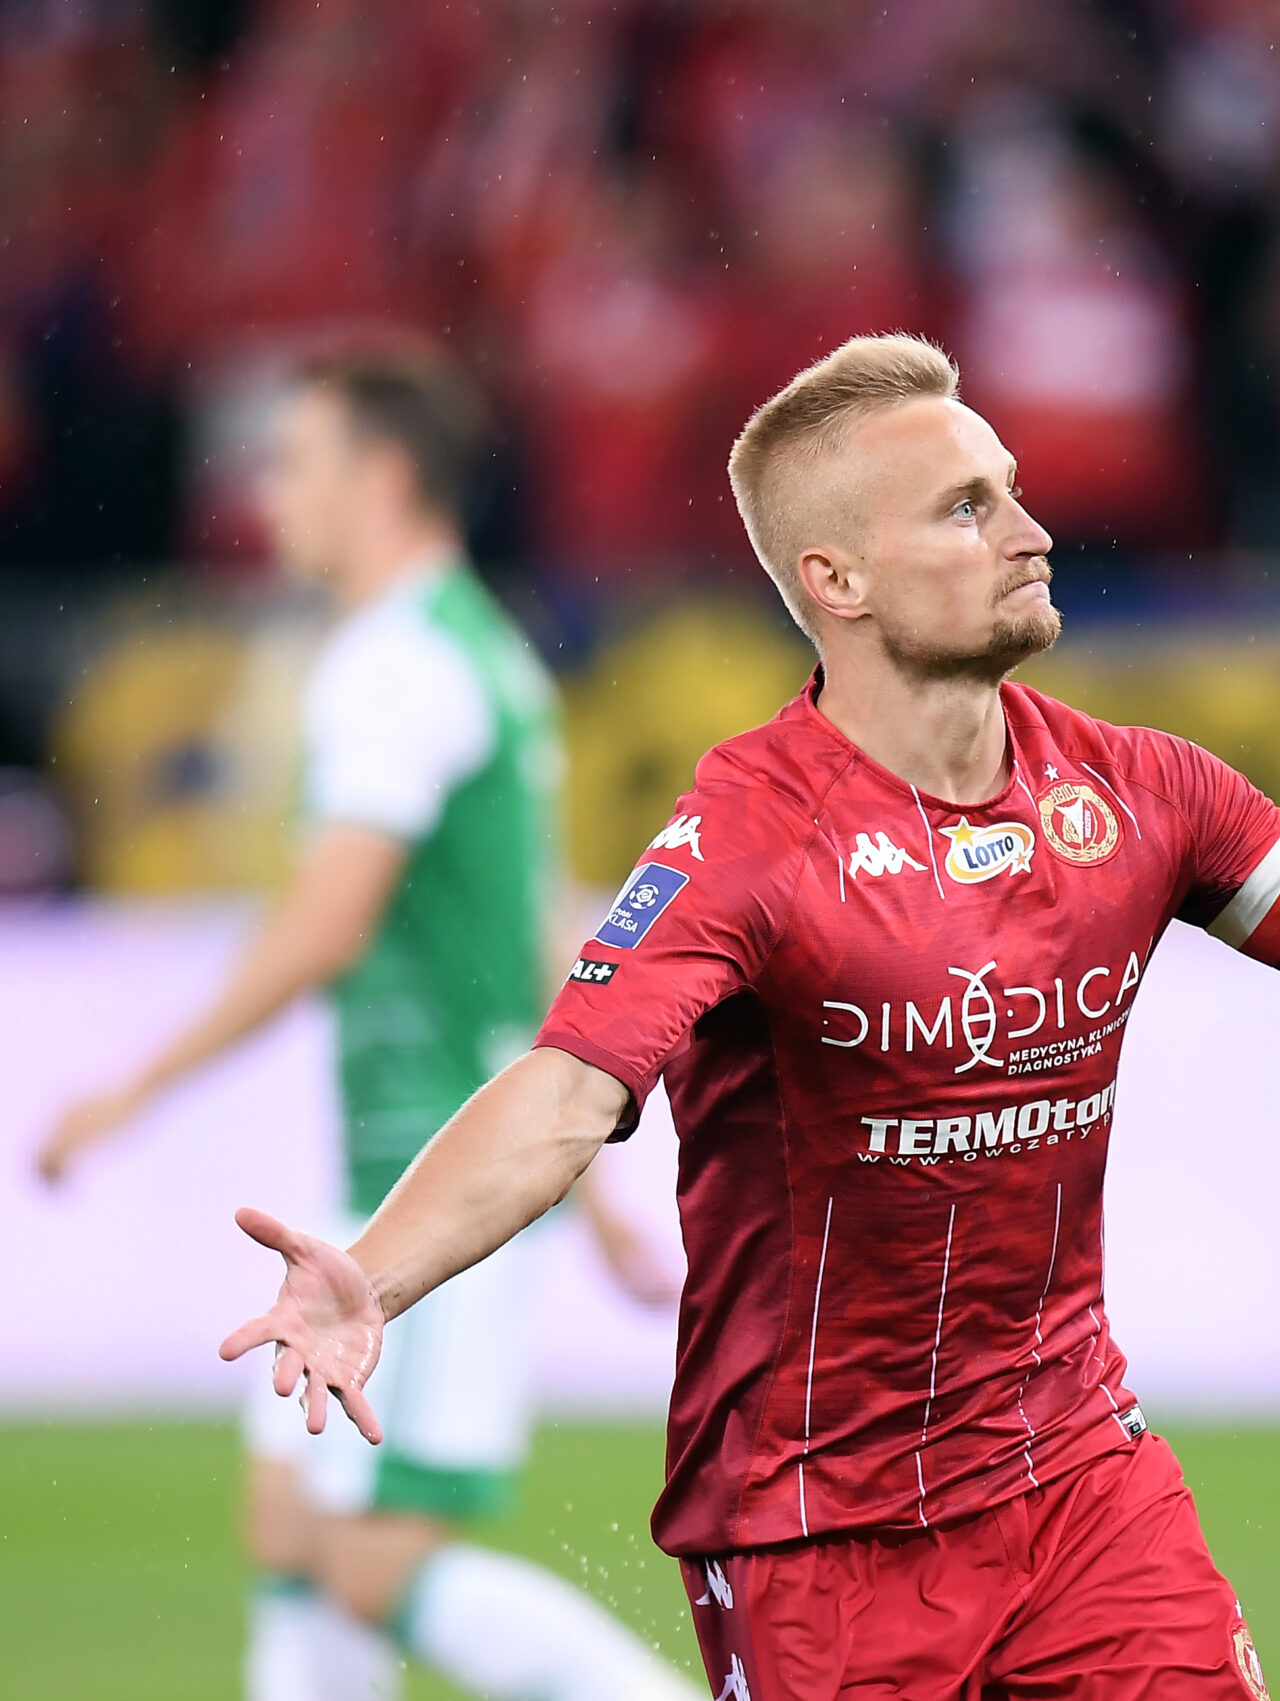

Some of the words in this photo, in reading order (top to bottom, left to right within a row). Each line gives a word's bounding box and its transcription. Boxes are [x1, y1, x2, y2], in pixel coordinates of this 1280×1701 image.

[963, 835, 1014, 869] LOTTO
[1007, 1041, 1102, 1076] DIAGNOSTYKA
[1009, 1036, 1085, 1063] MEDYCYNA
